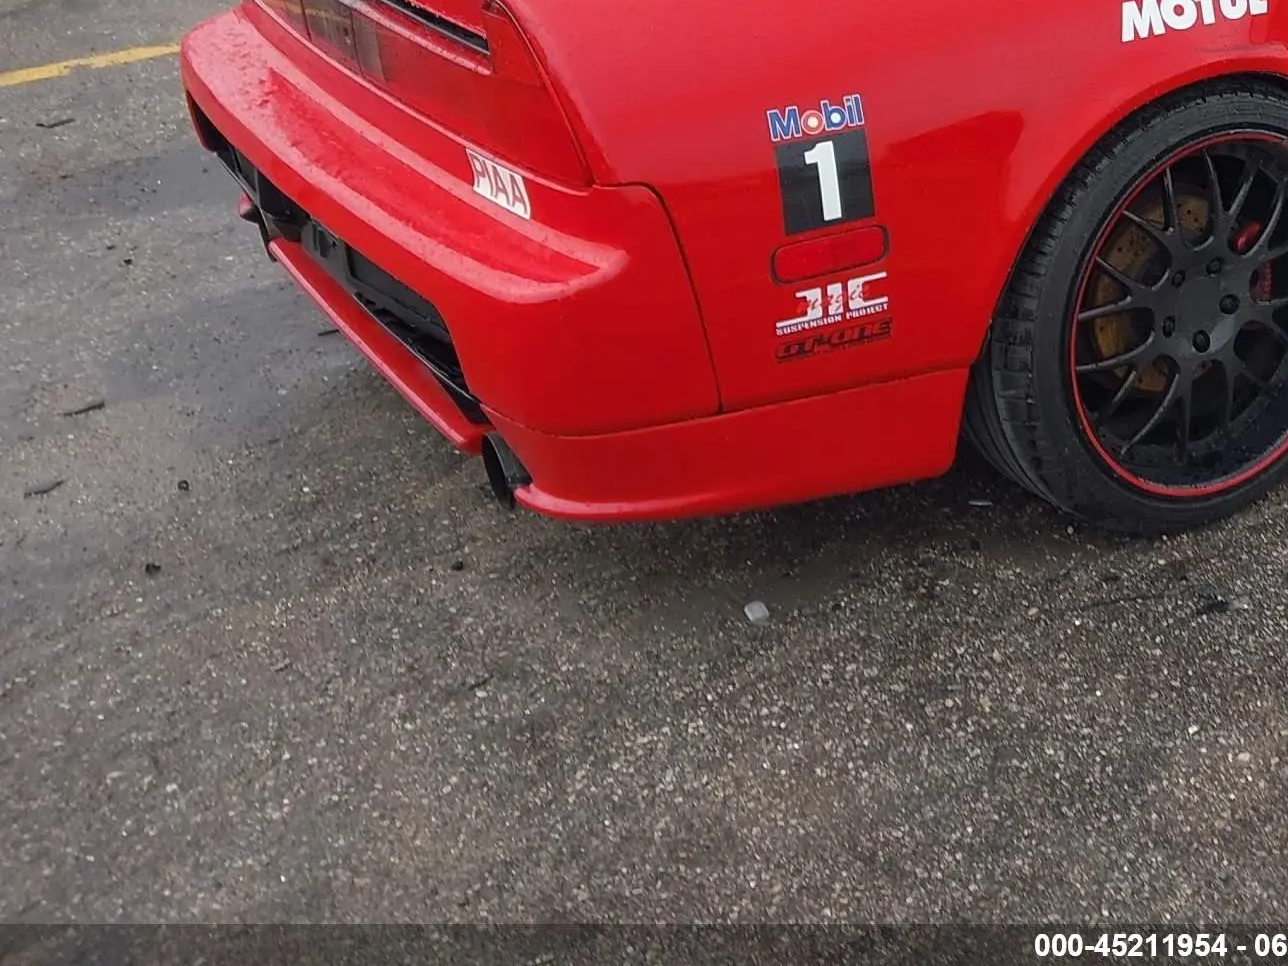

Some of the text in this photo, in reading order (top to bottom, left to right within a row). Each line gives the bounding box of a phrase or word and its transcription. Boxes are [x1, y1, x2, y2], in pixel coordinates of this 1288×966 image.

[767, 94, 864, 142] Mobil
[468, 152, 529, 216] PIAA
[804, 140, 842, 222] 1
[775, 302, 889, 336] SUSPENSION PROJECT
[776, 271, 889, 329] JIC
